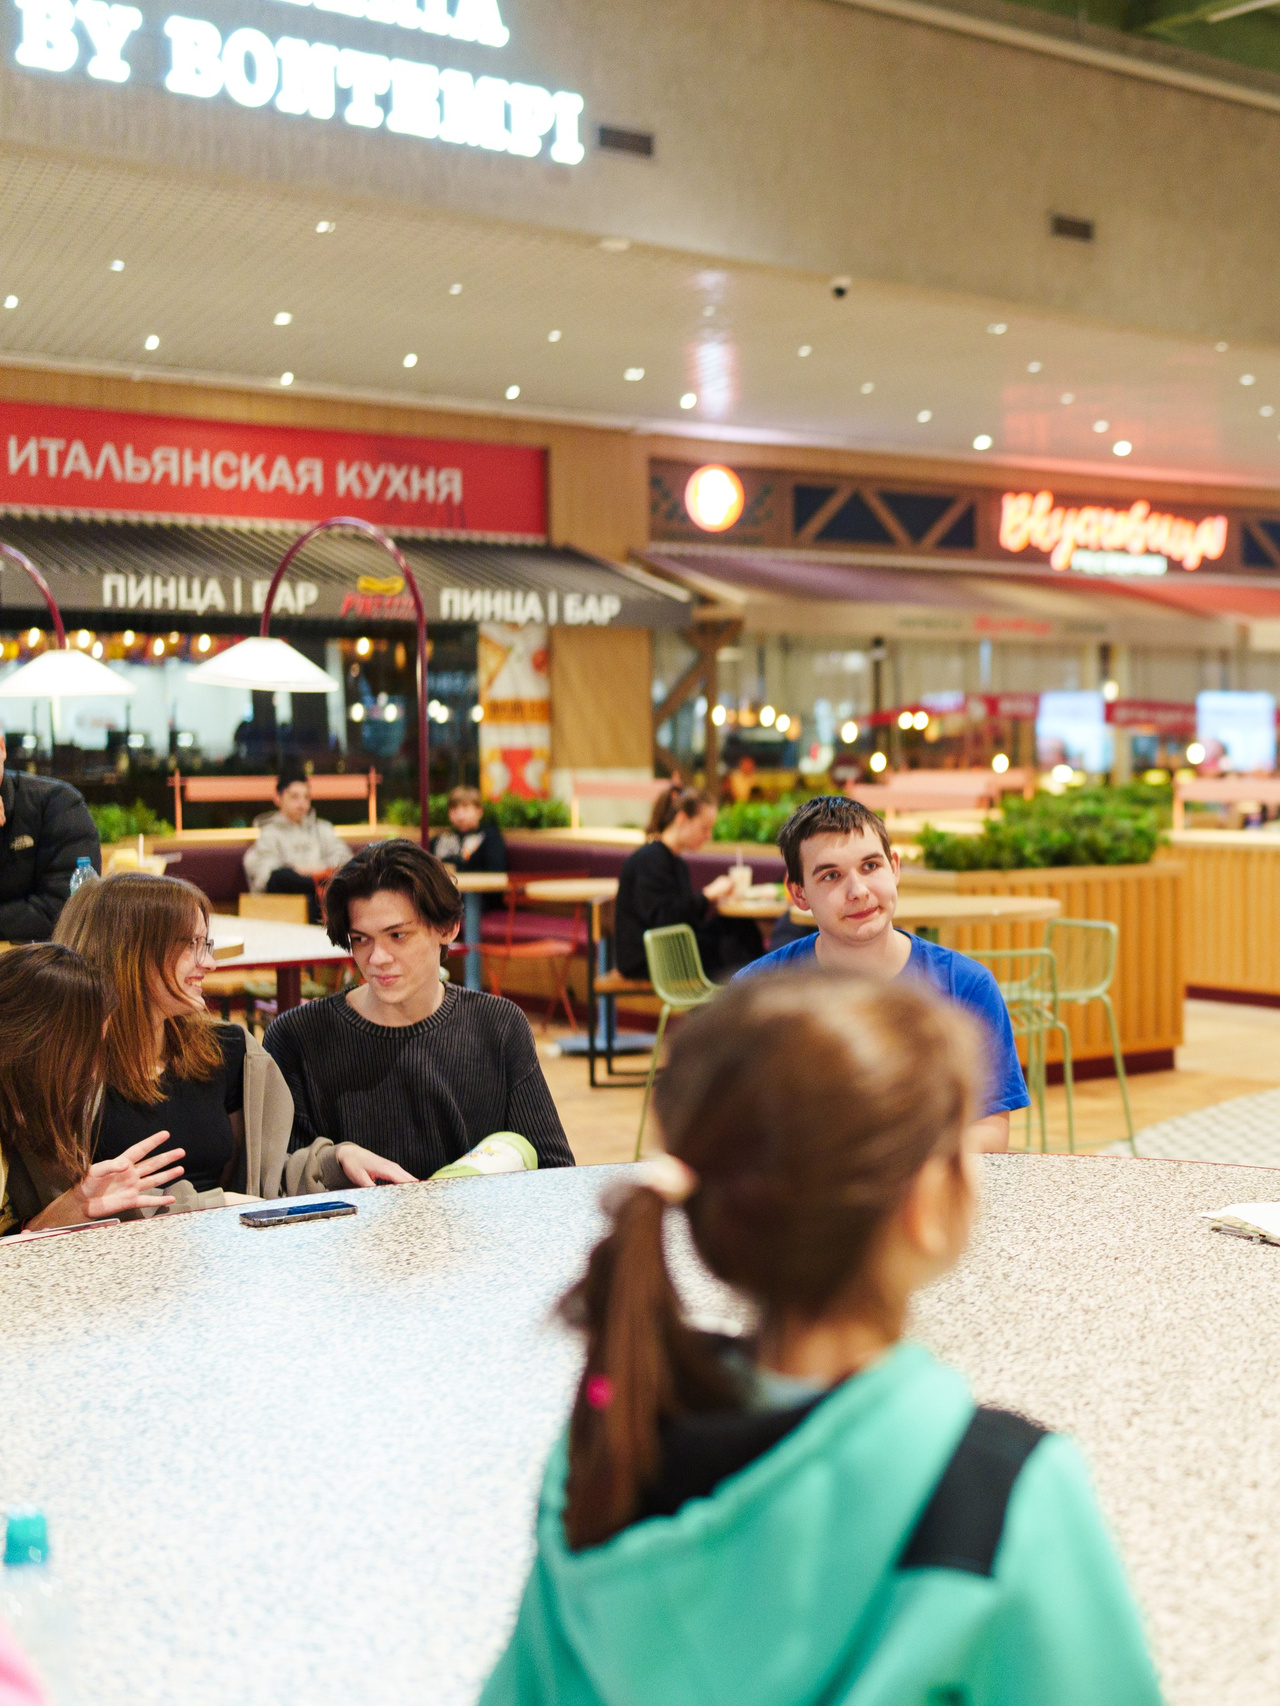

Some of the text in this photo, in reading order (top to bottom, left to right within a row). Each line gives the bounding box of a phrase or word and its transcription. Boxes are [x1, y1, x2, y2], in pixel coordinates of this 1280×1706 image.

[15, 0, 142, 83] BY
[164, 15, 585, 165] BONTEMPI
[8, 435, 463, 505] ИТАЛЬЯНСКАЯ КУХНЯ
[103, 574, 226, 615] ПИНЦА
[440, 588, 544, 624] ПИНЦА
[564, 593, 621, 626] БАР
